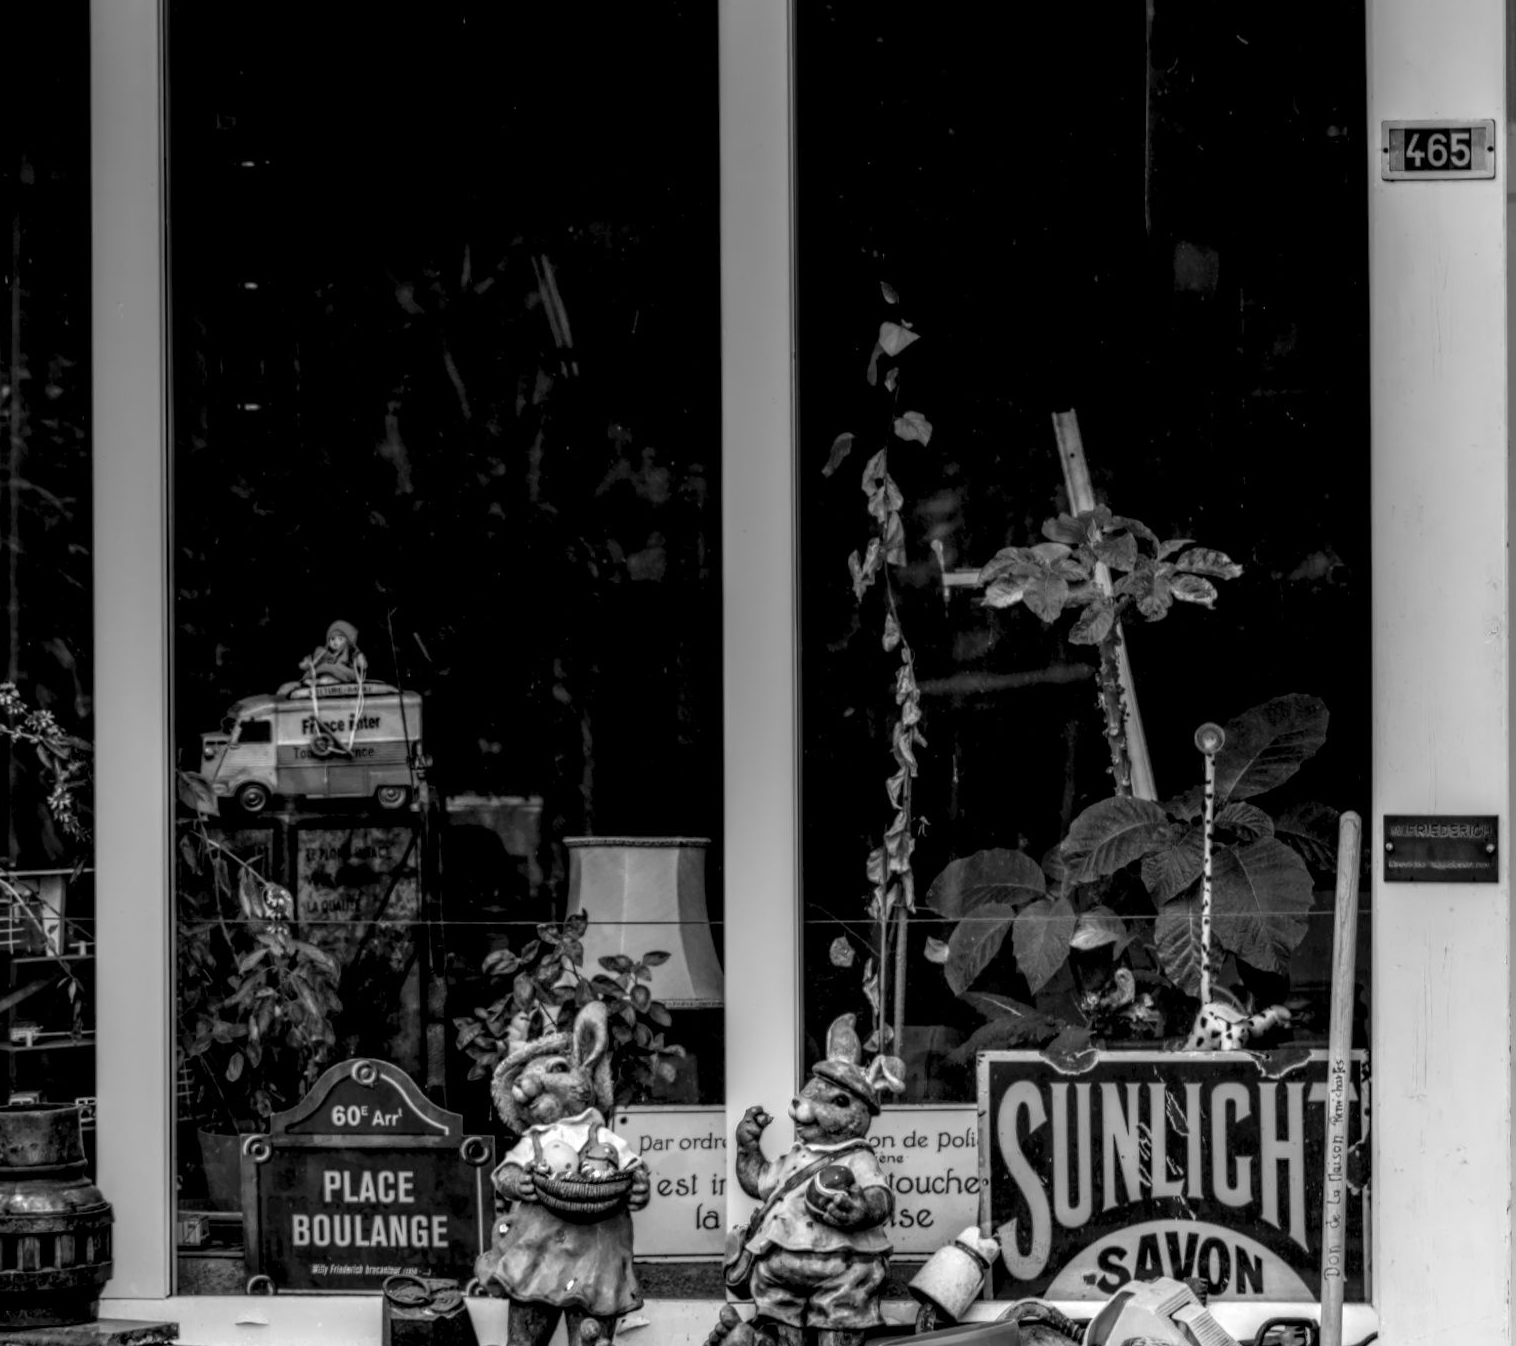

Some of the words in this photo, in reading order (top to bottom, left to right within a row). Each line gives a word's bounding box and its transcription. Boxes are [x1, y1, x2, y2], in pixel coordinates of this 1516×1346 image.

[1405, 132, 1471, 168] 465
[903, 1130, 928, 1148] de
[937, 1127, 979, 1153] Poli
[323, 1170, 415, 1203] PLACE
[291, 1214, 449, 1248] BOULANGE
[695, 1202, 722, 1231] la
